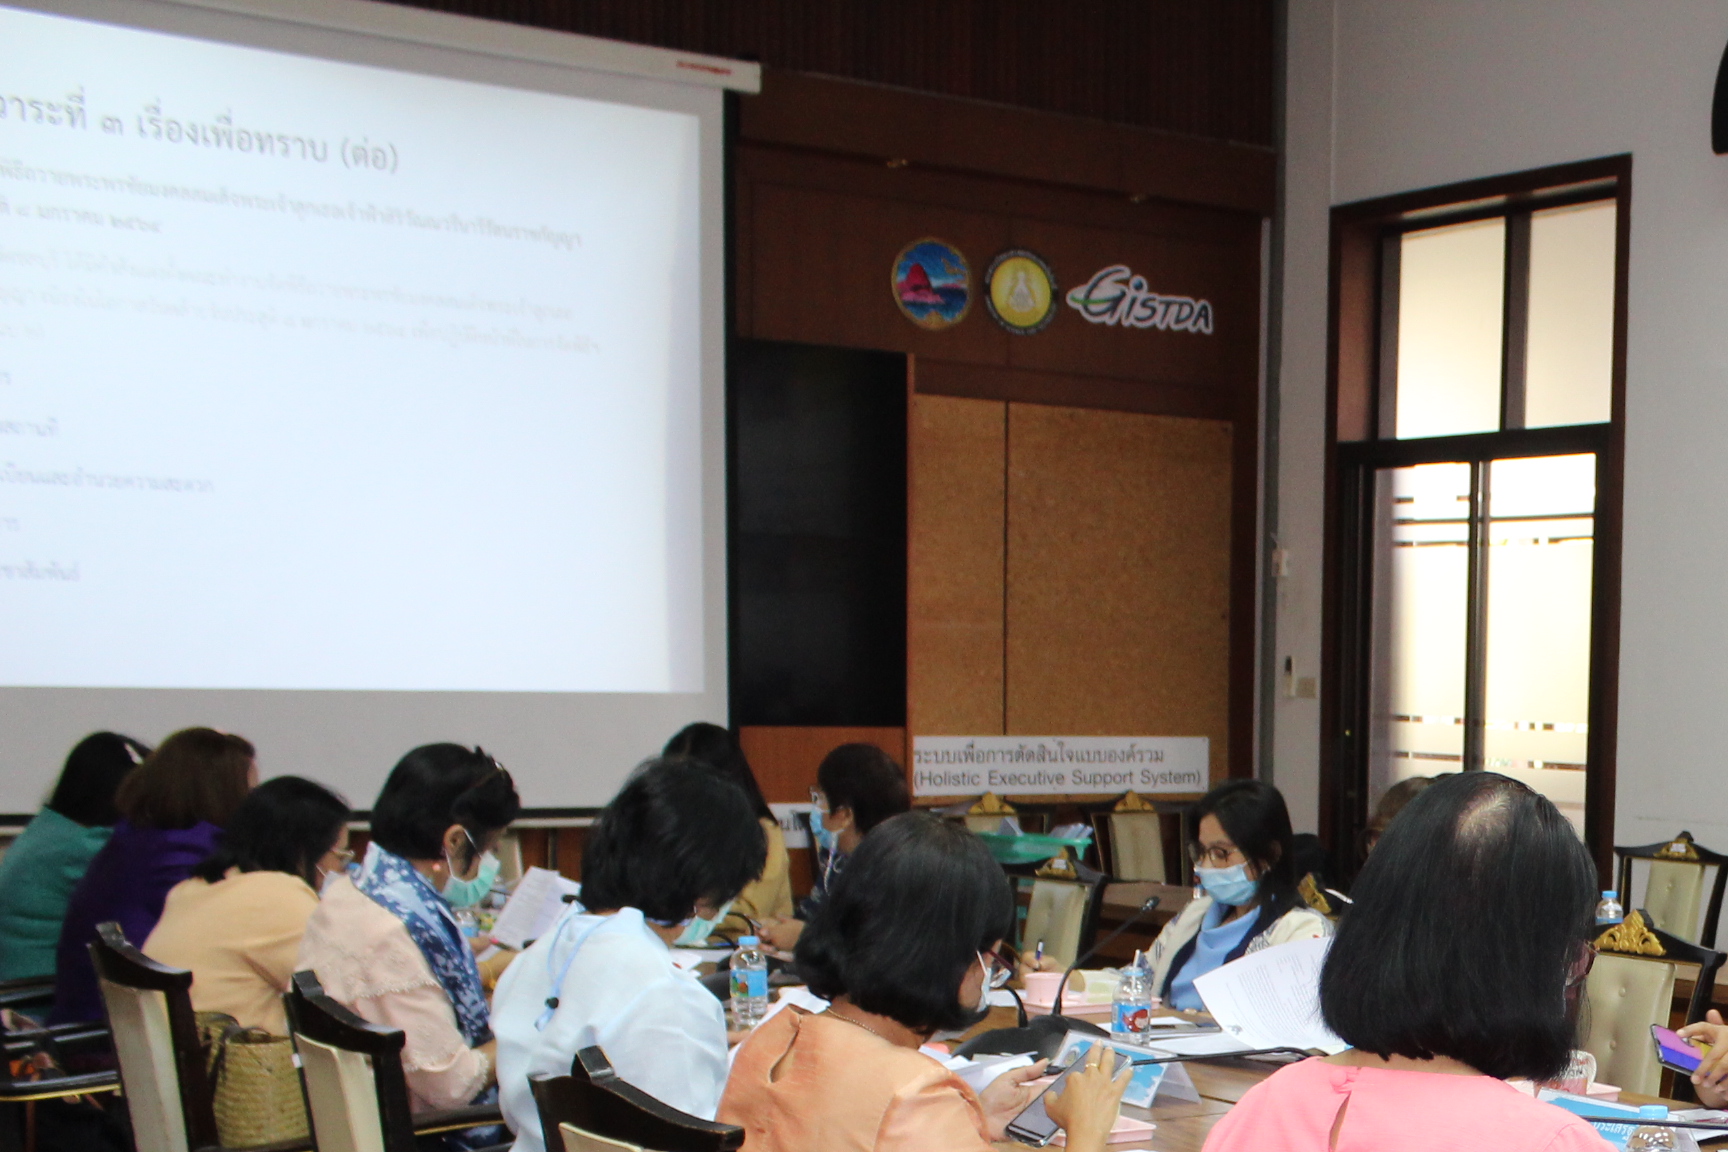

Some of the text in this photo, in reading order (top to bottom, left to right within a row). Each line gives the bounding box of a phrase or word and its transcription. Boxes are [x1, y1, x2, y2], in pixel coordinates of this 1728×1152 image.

[138, 100, 328, 162] เรื่องเพื่อทราบ
[340, 137, 398, 172] (ต่อ)
[913, 769, 1201, 790] (Holistic Executive Support System)
